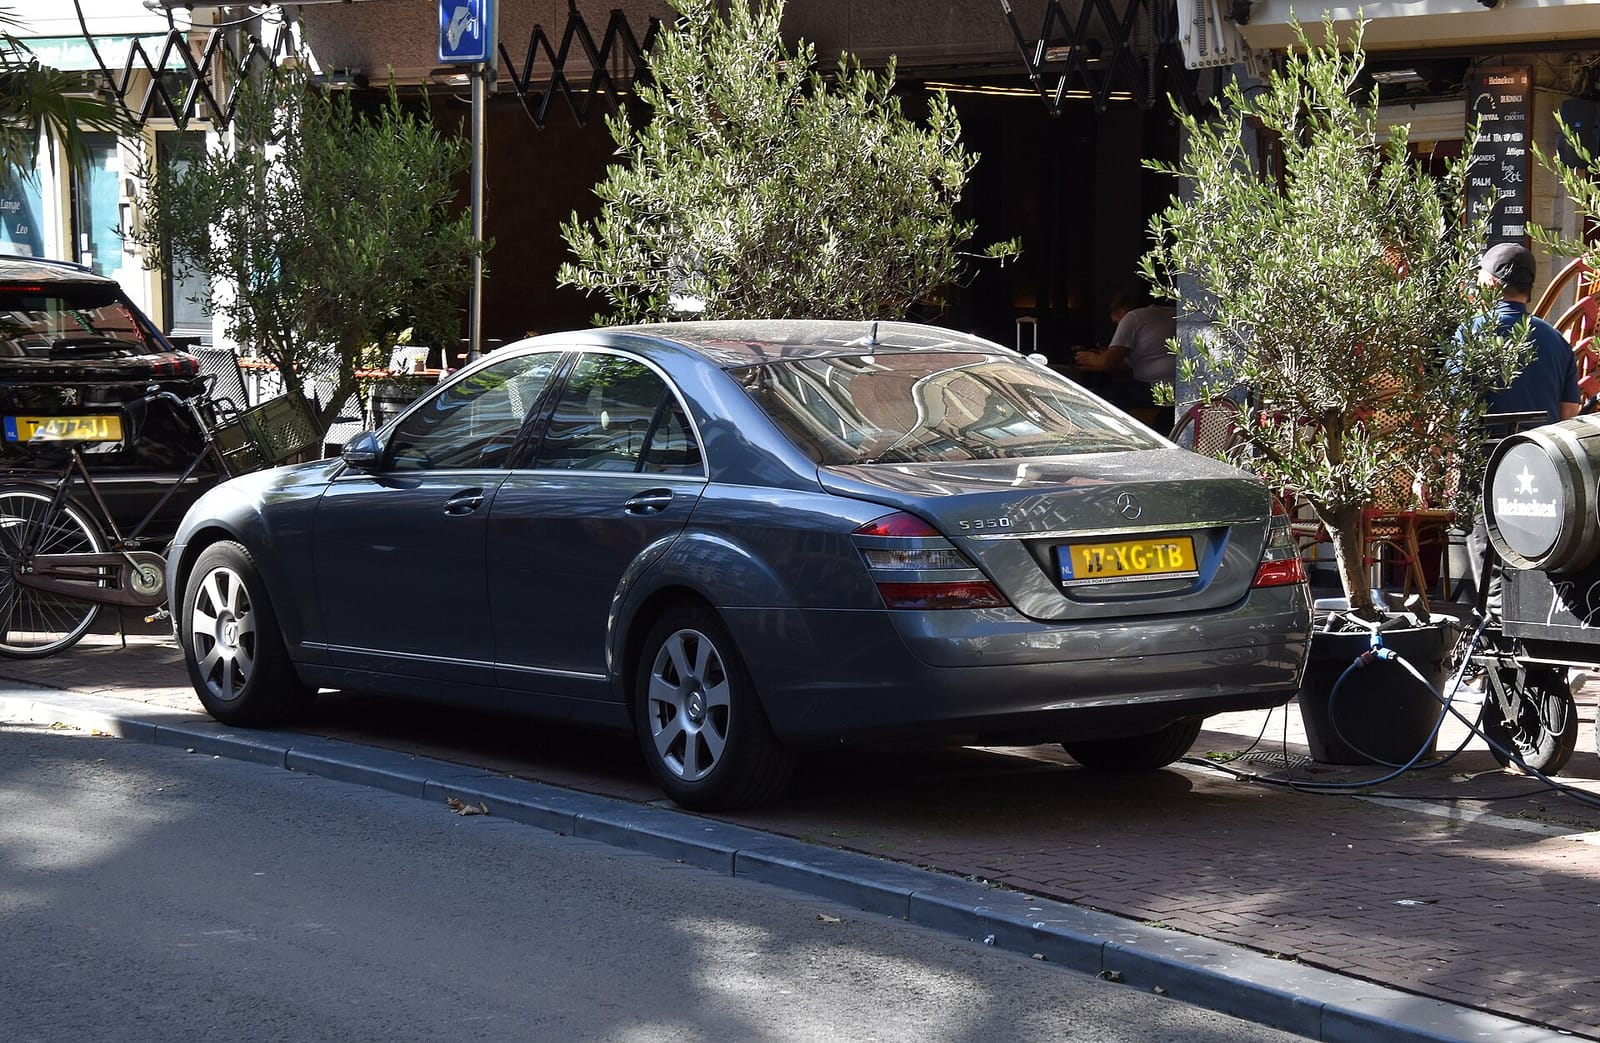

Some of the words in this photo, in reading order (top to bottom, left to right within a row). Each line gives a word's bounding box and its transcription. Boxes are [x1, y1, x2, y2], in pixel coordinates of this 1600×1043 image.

[1471, 177, 1491, 187] PALM
[15, 223, 29, 235] Leo
[972, 517, 1010, 529] 350
[1061, 566, 1073, 575] NL
[1083, 544, 1184, 572] 17-XG-TB
